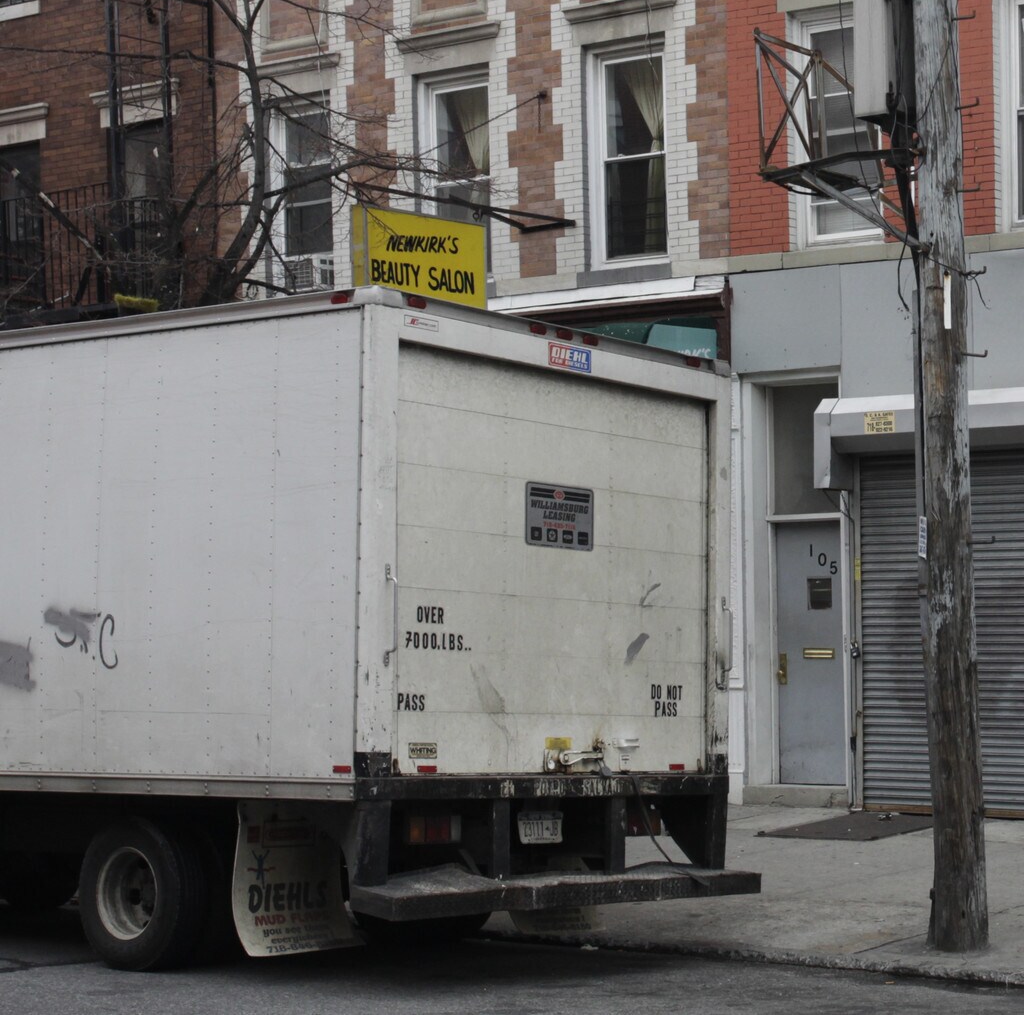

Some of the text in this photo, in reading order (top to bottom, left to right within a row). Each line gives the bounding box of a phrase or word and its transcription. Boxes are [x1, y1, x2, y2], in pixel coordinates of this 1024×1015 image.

[386, 235, 459, 254] NEWKIRK'S
[371, 259, 475, 295] BEAUTY SALON
[551, 347, 588, 363] DIEHL
[531, 499, 589, 514] WILLIAMSBURG
[543, 511, 576, 522] LEASING
[417, 606, 444, 624] OVER
[651, 684, 682, 701] DO NOT
[397, 693, 425, 712] PASS
[654, 702, 678, 717] PASS
[248, 881, 329, 914] DIEHLS
[254, 915, 286, 927] MUD
[263, 927, 283, 938] you
